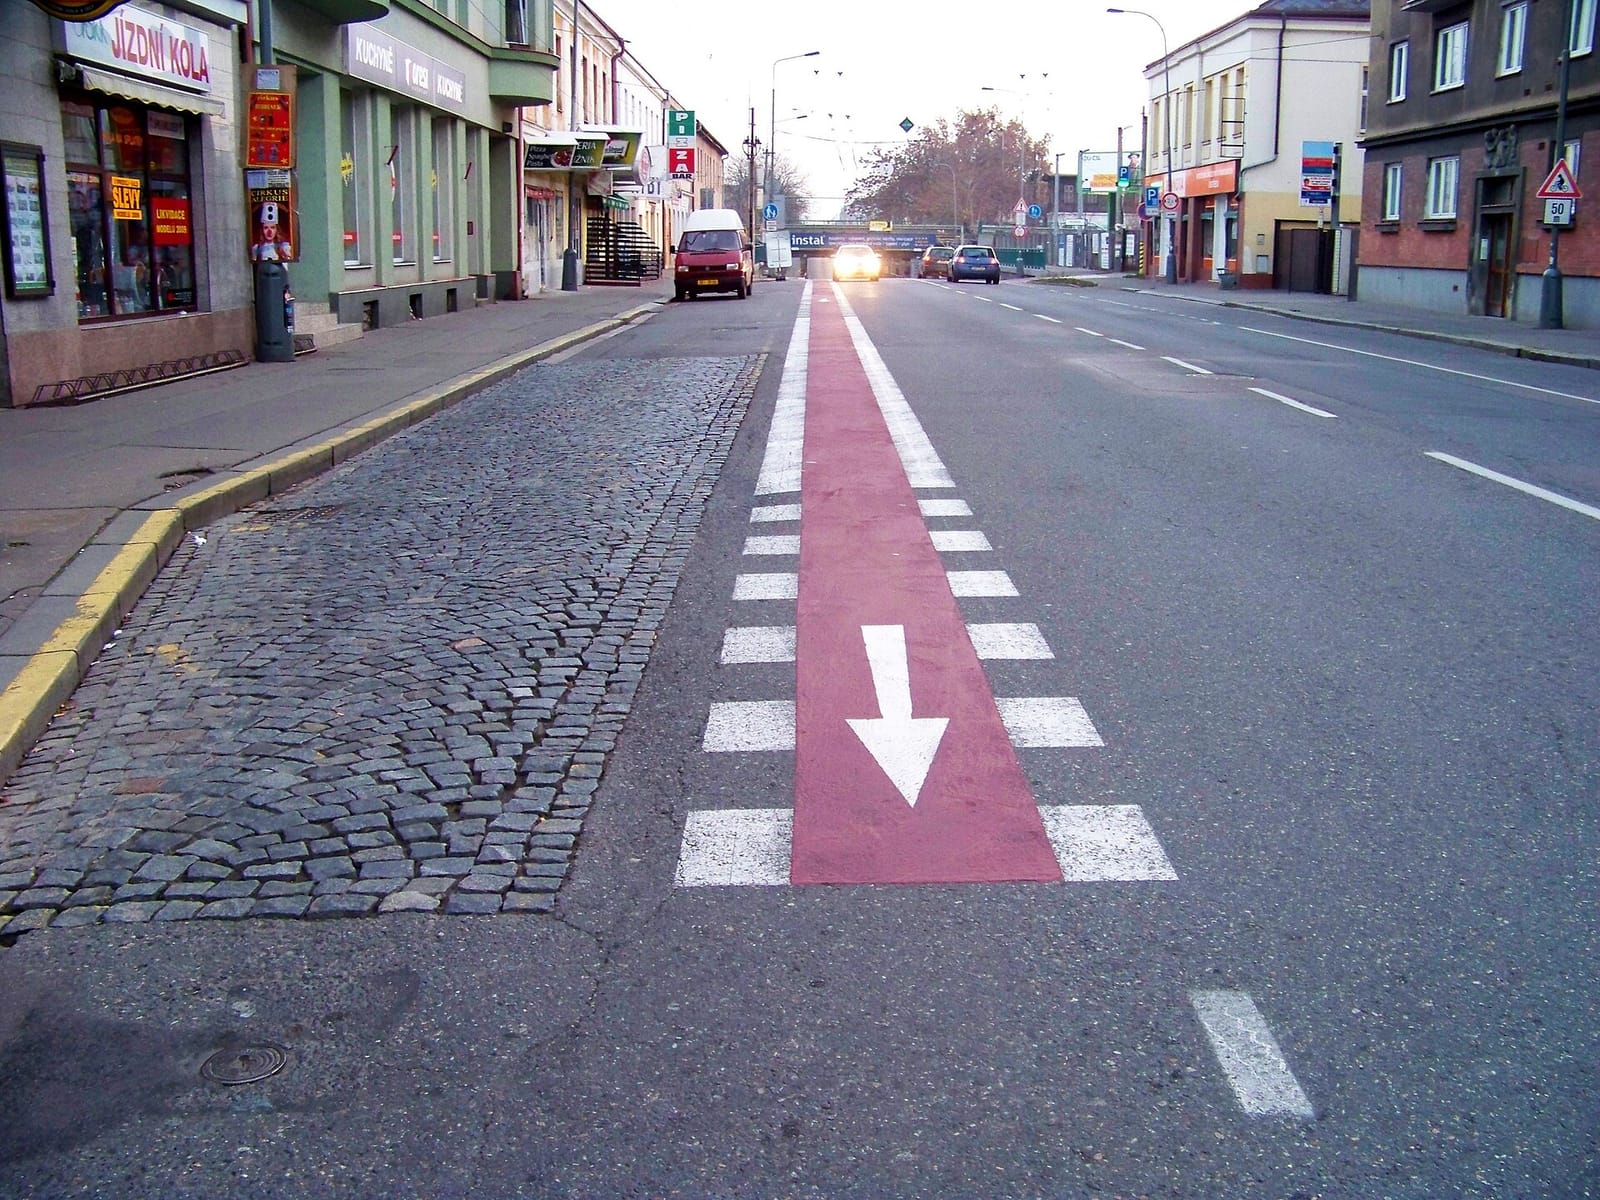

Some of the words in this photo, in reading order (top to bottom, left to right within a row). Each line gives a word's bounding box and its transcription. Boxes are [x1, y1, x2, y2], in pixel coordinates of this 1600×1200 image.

[112, 9, 165, 71] JÍZDNÍ
[169, 36, 209, 83] KOLA
[355, 36, 393, 74] KUCHYNĚ
[576, 141, 597, 150] ERIA
[675, 112, 689, 173] PIZZA
[1120, 167, 1127, 176] P
[112, 187, 141, 210] SLEVY
[251, 189, 289, 197] CIRKUS
[1148, 189, 1156, 200] P
[156, 208, 186, 220] LIKVIDACE
[1551, 203, 1564, 215] 50
[791, 234, 824, 246] instal
